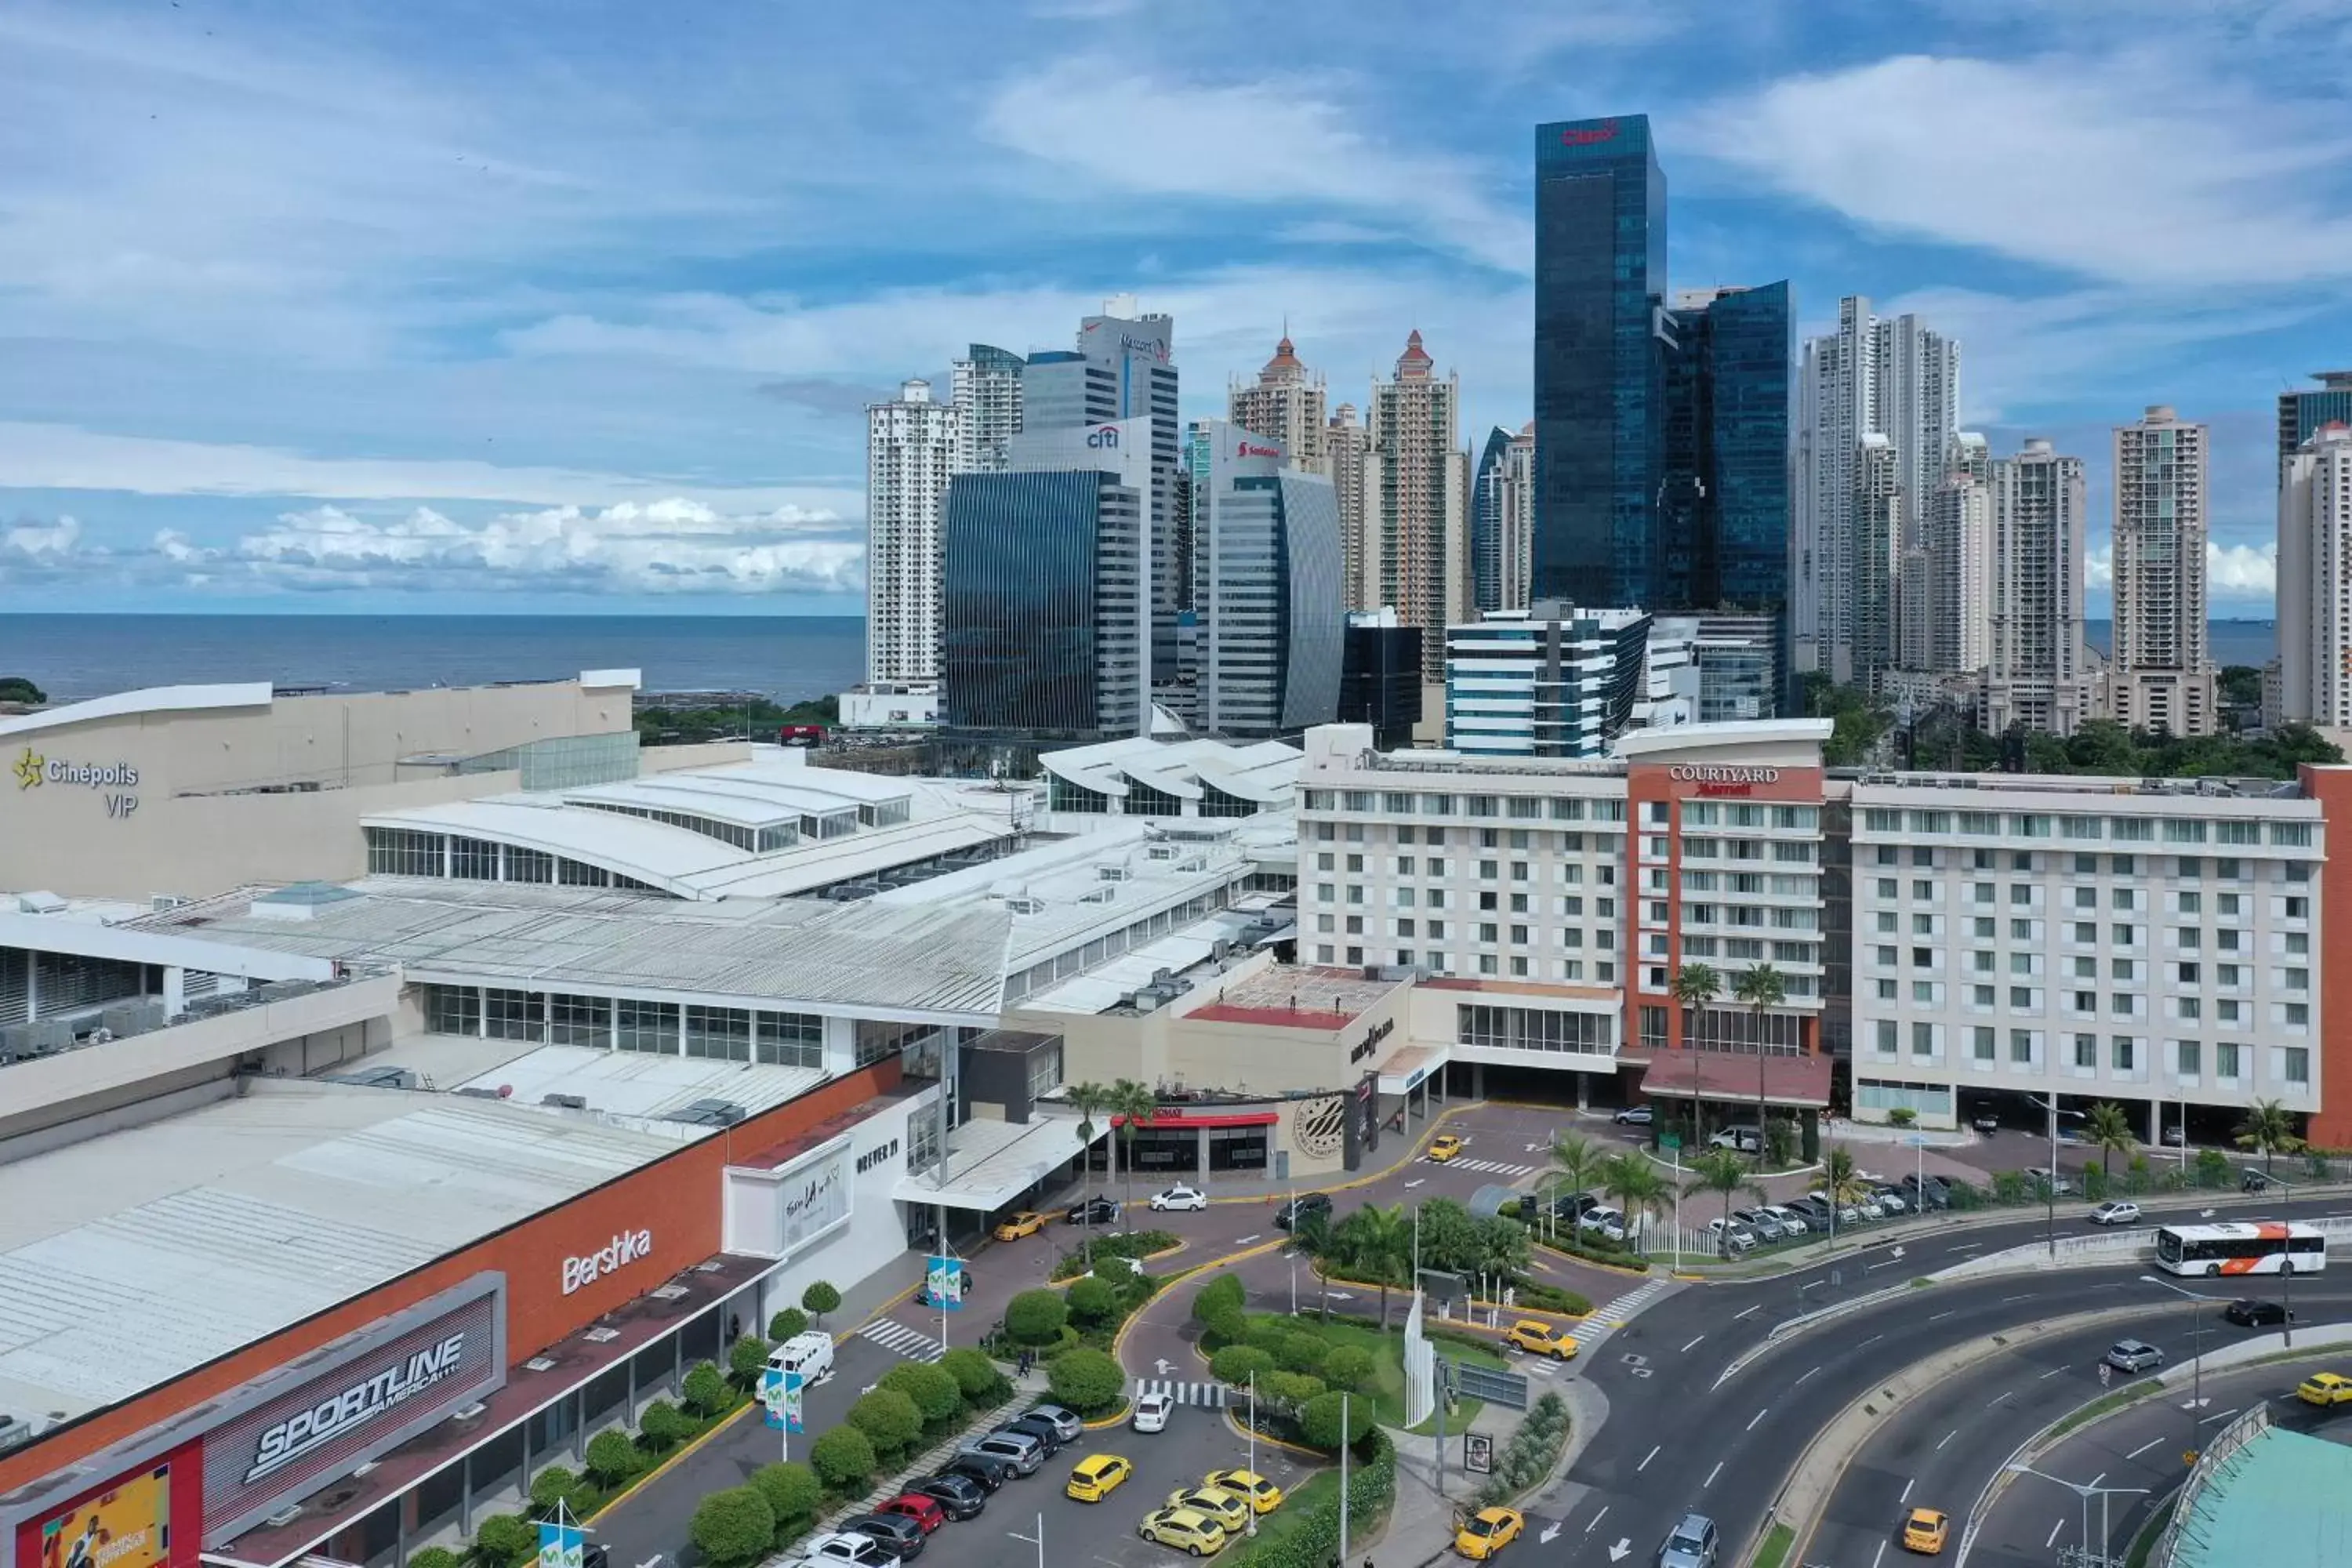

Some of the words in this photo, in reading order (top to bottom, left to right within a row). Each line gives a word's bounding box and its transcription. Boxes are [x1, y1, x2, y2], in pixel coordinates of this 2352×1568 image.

[1087, 427, 1118, 448] citi
[49, 759, 139, 789] Cinépolis
[1670, 765, 1779, 784] COURTYARD
[104, 793, 139, 818] VIP
[562, 1229, 651, 1295] Bershka
[258, 1333, 464, 1465] SPORTLINE
